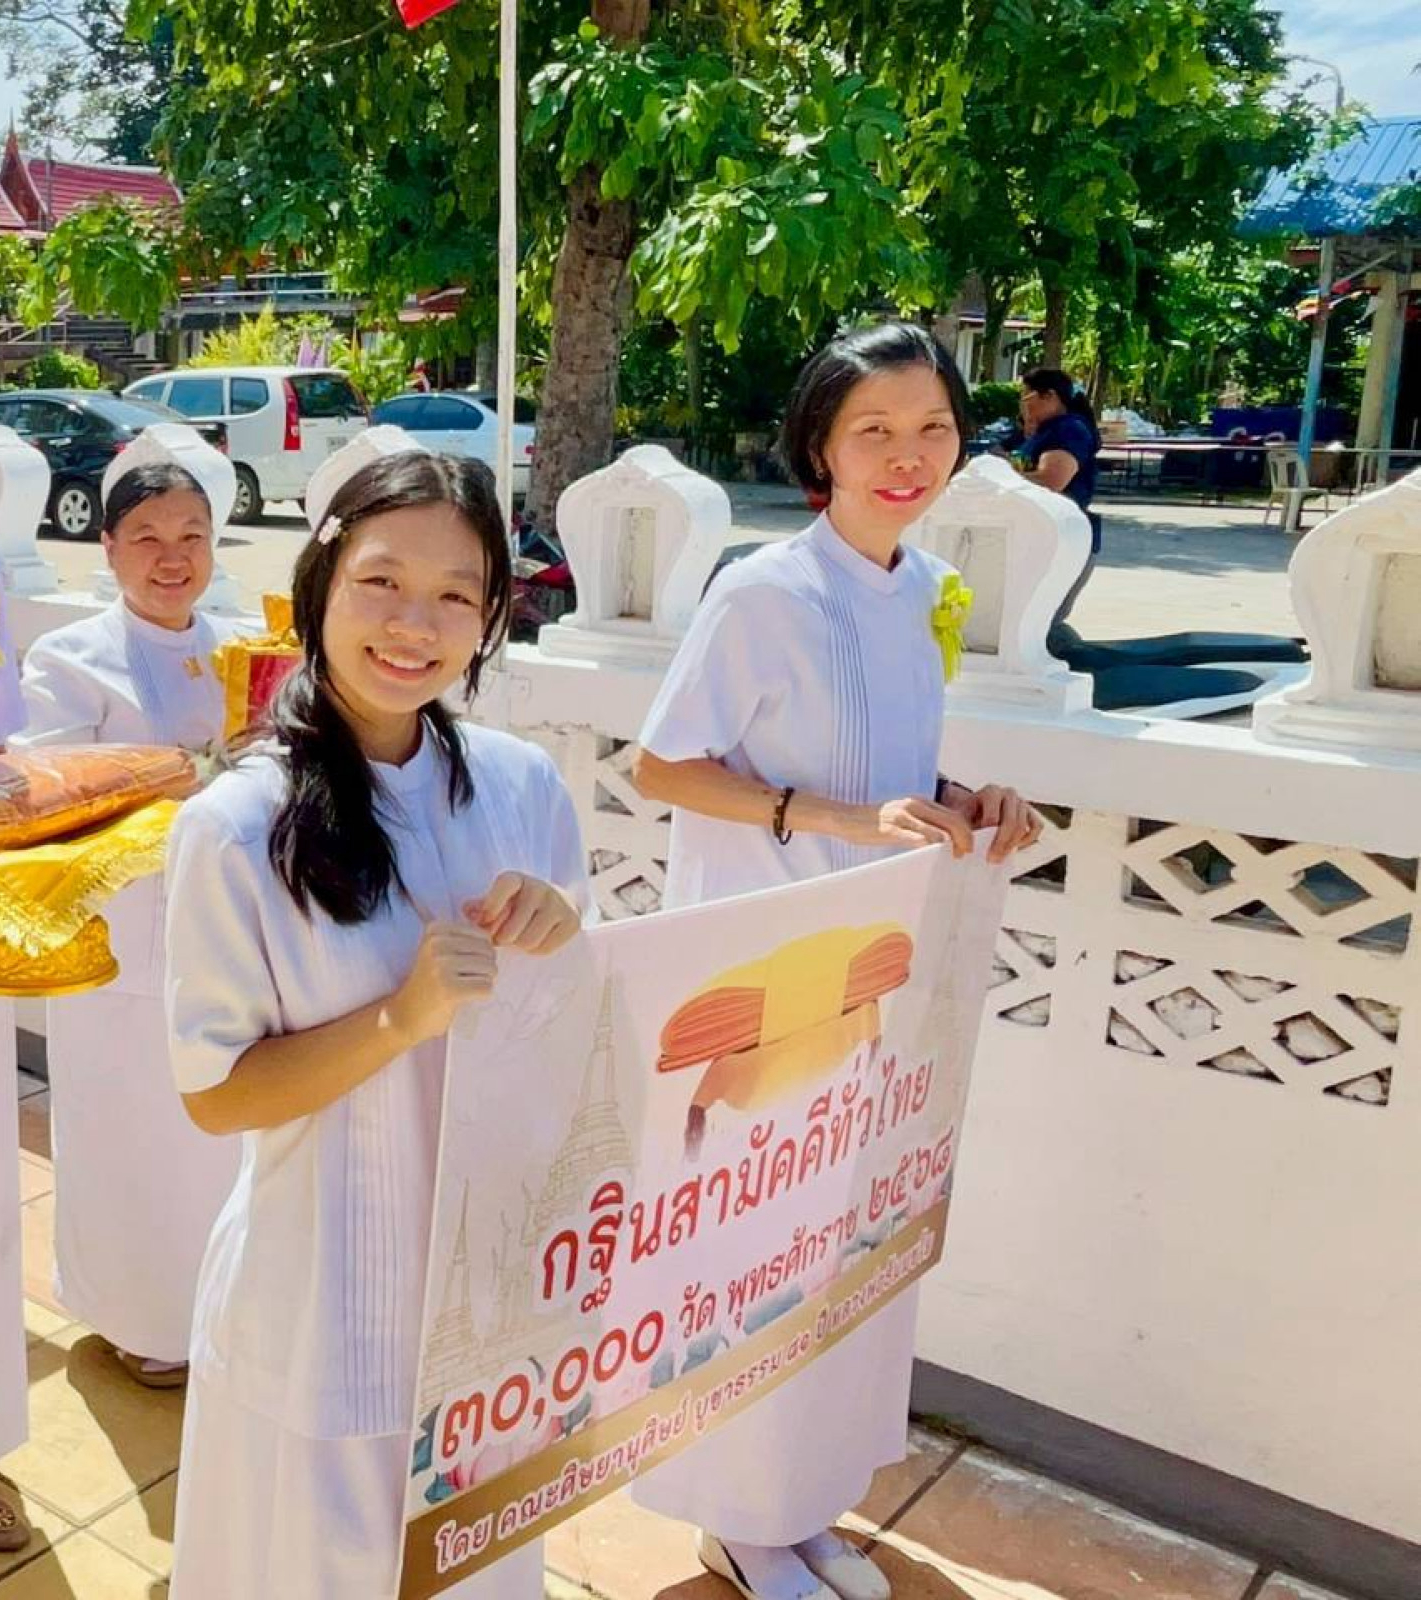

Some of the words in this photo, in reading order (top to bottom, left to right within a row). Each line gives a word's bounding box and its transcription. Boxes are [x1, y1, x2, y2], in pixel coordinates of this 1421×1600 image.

[442, 1310, 664, 1459] ๓๐,๐๐๐
[679, 1282, 717, 1338] วัด
[728, 1203, 859, 1329] พุทธศักราช
[869, 1125, 953, 1222] ๒๕๖๘
[543, 1054, 932, 1313] กฐินสามัคคีทั่วไทย
[436, 1520, 491, 1569] โดย
[498, 1393, 689, 1538] คณะศิษยานุศิษย์
[695, 1351, 782, 1430] บูชาธรรม
